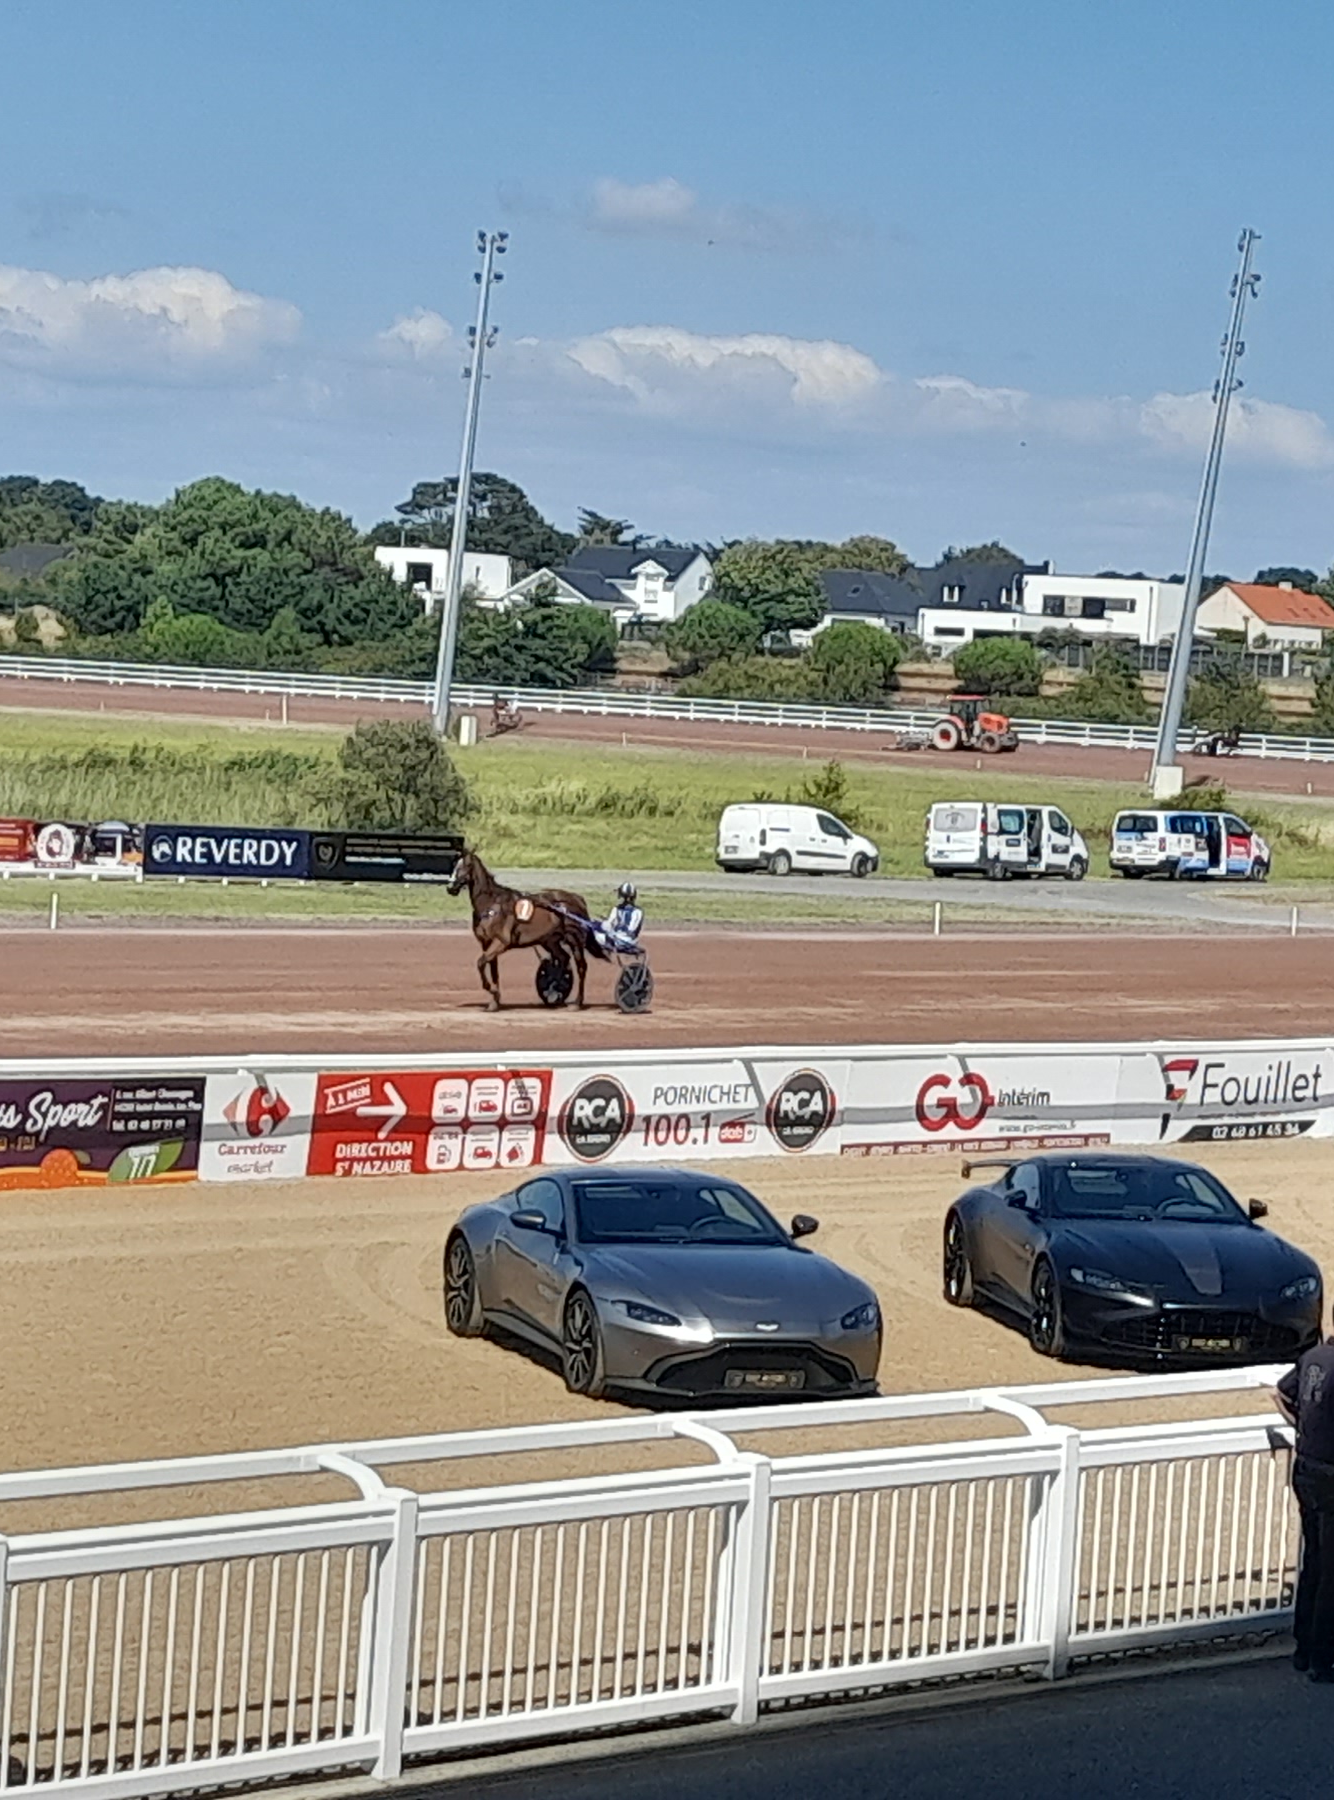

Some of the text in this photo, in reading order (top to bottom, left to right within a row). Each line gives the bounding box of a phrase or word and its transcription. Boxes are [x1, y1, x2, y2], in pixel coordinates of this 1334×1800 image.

[175, 835, 299, 867] REVERDY
[652, 1083, 753, 1106] PORNICHET
[1199, 1060, 1323, 1107] Fouillet
[25, 1091, 110, 1143] Sport
[572, 1097, 622, 1129] RCA
[780, 1090, 825, 1120] RCA
[642, 1113, 712, 1147] 100.1
[218, 1142, 288, 1156] Carrefour
[335, 1141, 414, 1159] DIRECTION
[352, 1159, 414, 1175] NAZAIRE
